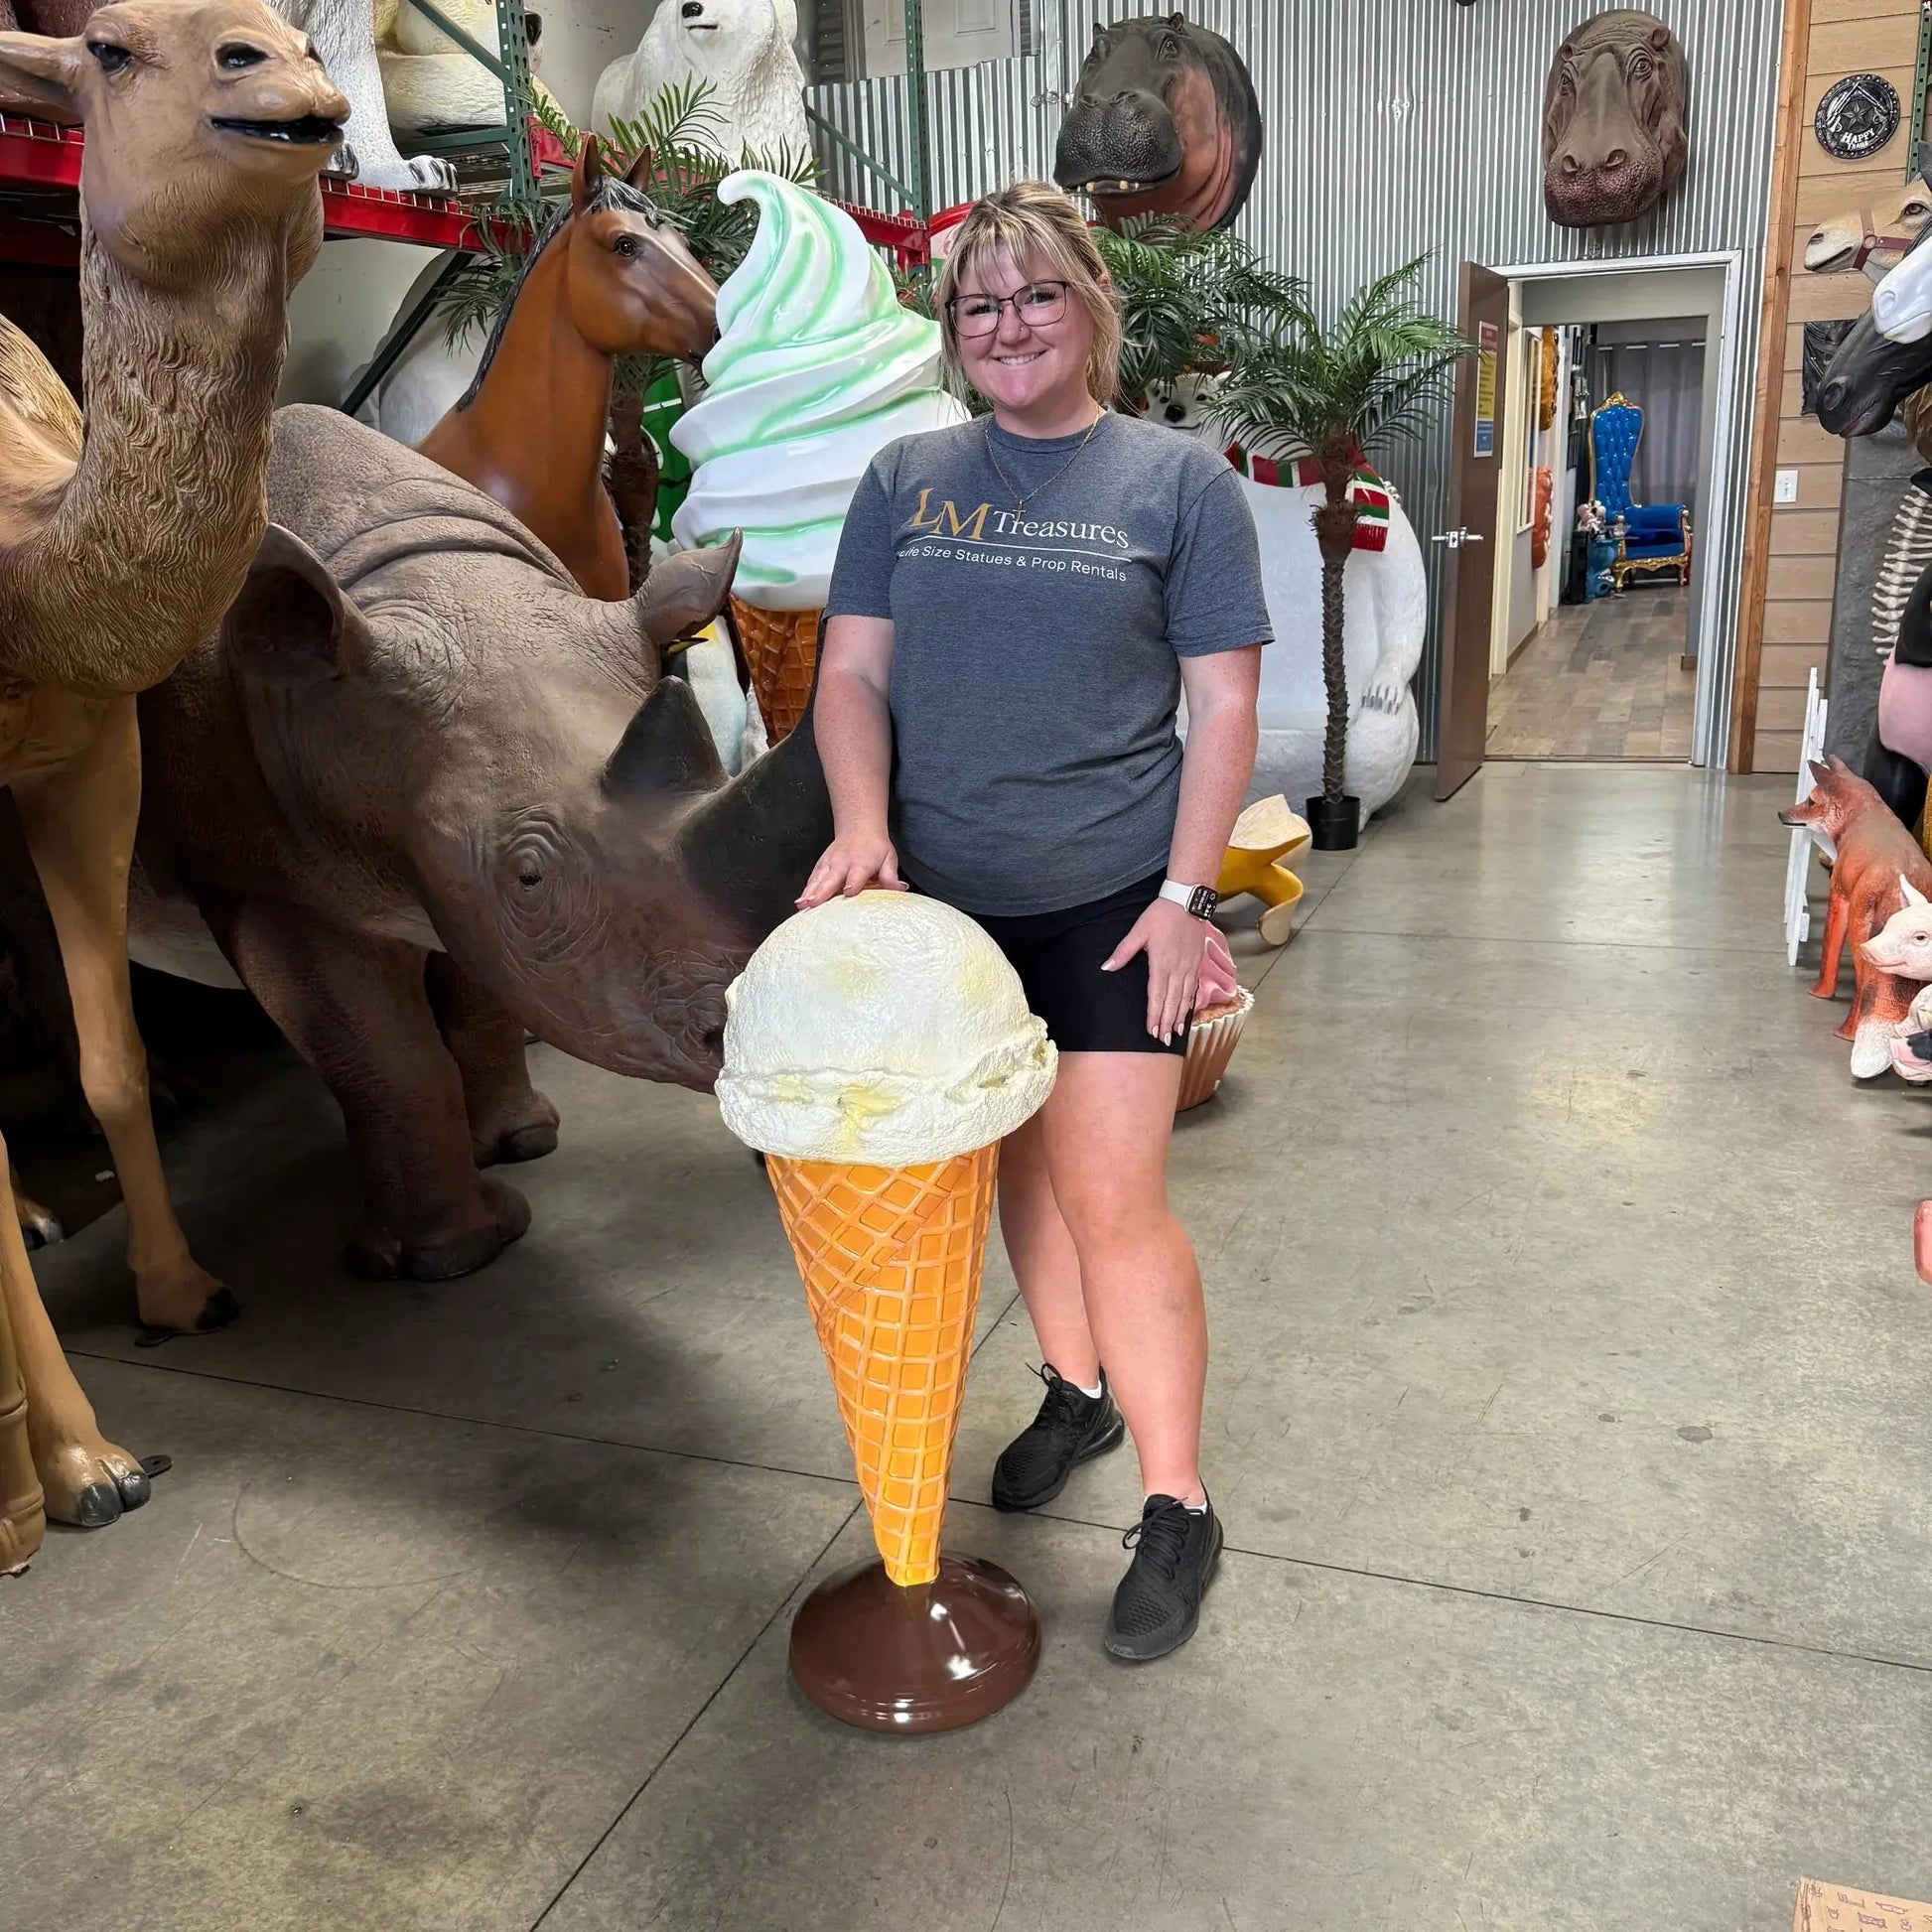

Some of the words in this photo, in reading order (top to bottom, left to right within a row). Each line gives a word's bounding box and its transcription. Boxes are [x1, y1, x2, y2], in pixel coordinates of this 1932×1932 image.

[1841, 128, 1874, 143] HAPPY
[910, 487, 993, 540] LM
[993, 510, 1129, 549] Treasures
[921, 545, 951, 558] Size
[955, 549, 1012, 566] Statues
[1016, 556, 1027, 567] &
[1032, 557, 1066, 572] Prop
[1070, 561, 1127, 582] Rentals
